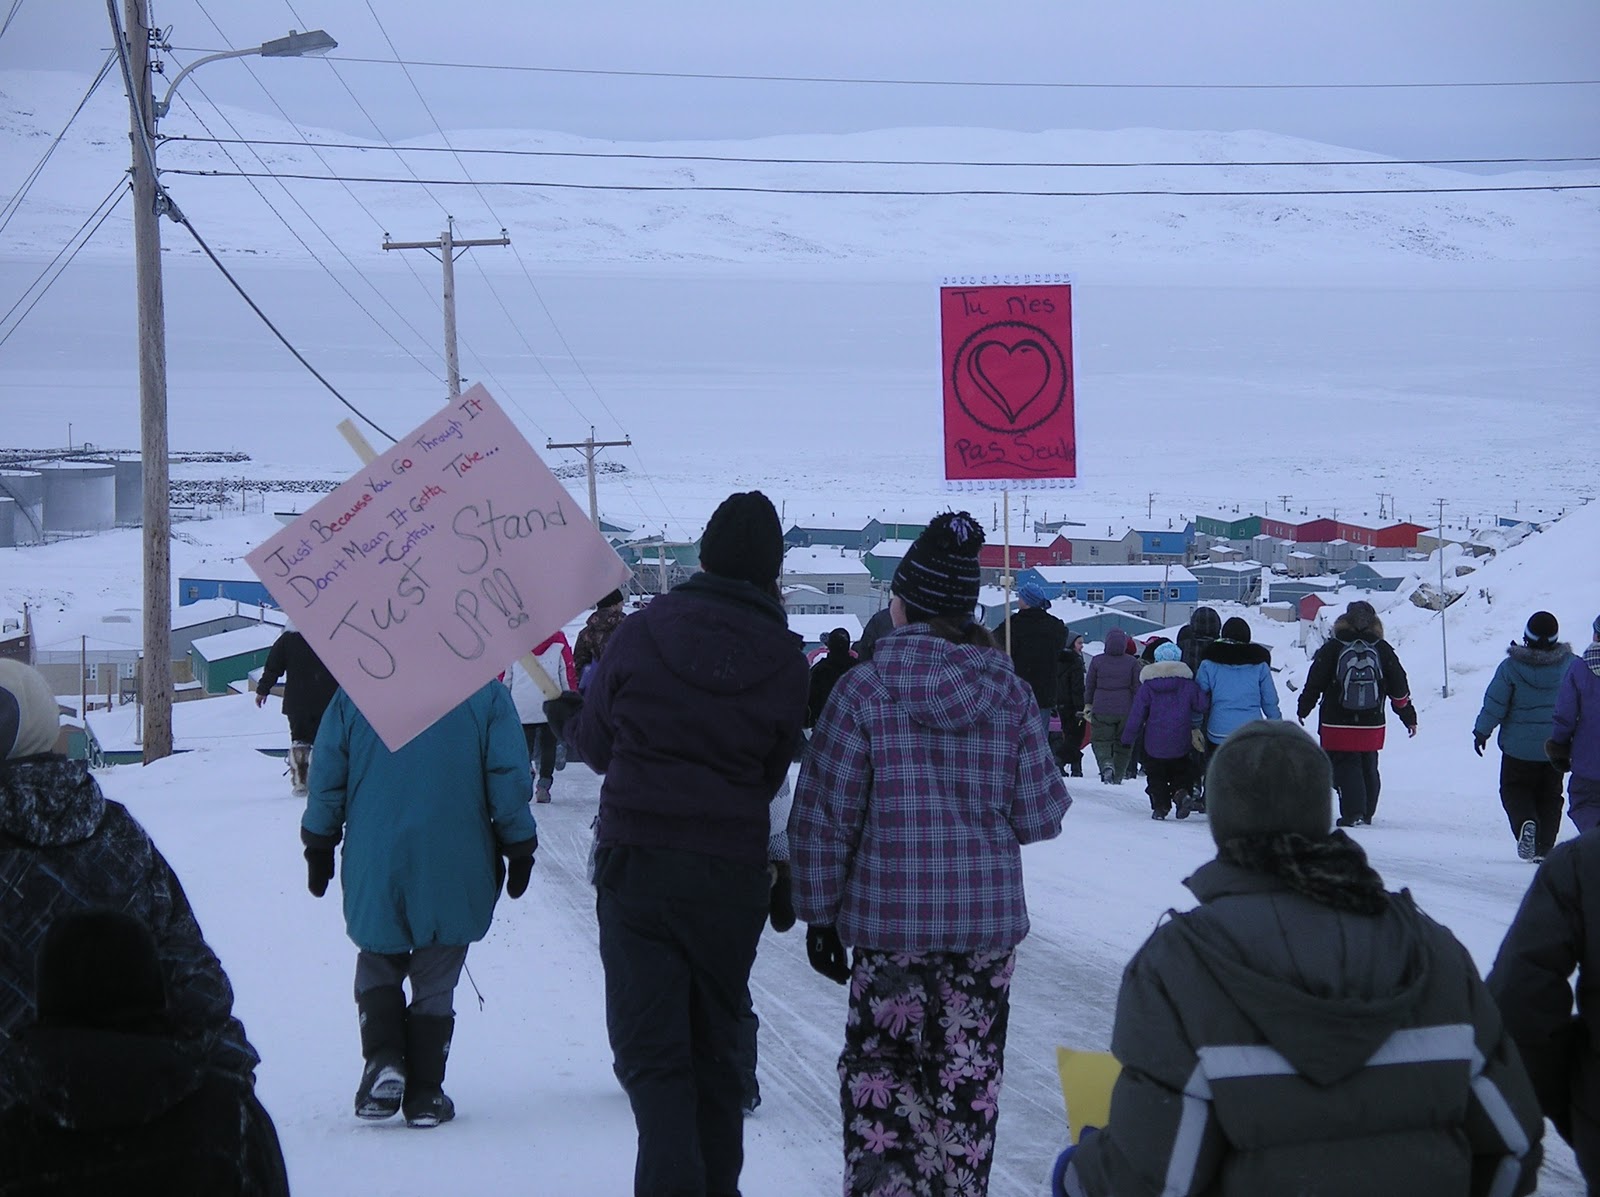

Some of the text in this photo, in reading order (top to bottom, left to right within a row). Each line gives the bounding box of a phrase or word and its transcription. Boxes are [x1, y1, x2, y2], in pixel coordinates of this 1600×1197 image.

[951, 290, 988, 317] Tu
[263, 398, 484, 578] Just Because You Go Through It
[953, 438, 1006, 468] Pas
[341, 529, 390, 562] Mean
[385, 507, 408, 530] It
[408, 484, 448, 514] Gotta
[328, 499, 568, 680] Just Stand
